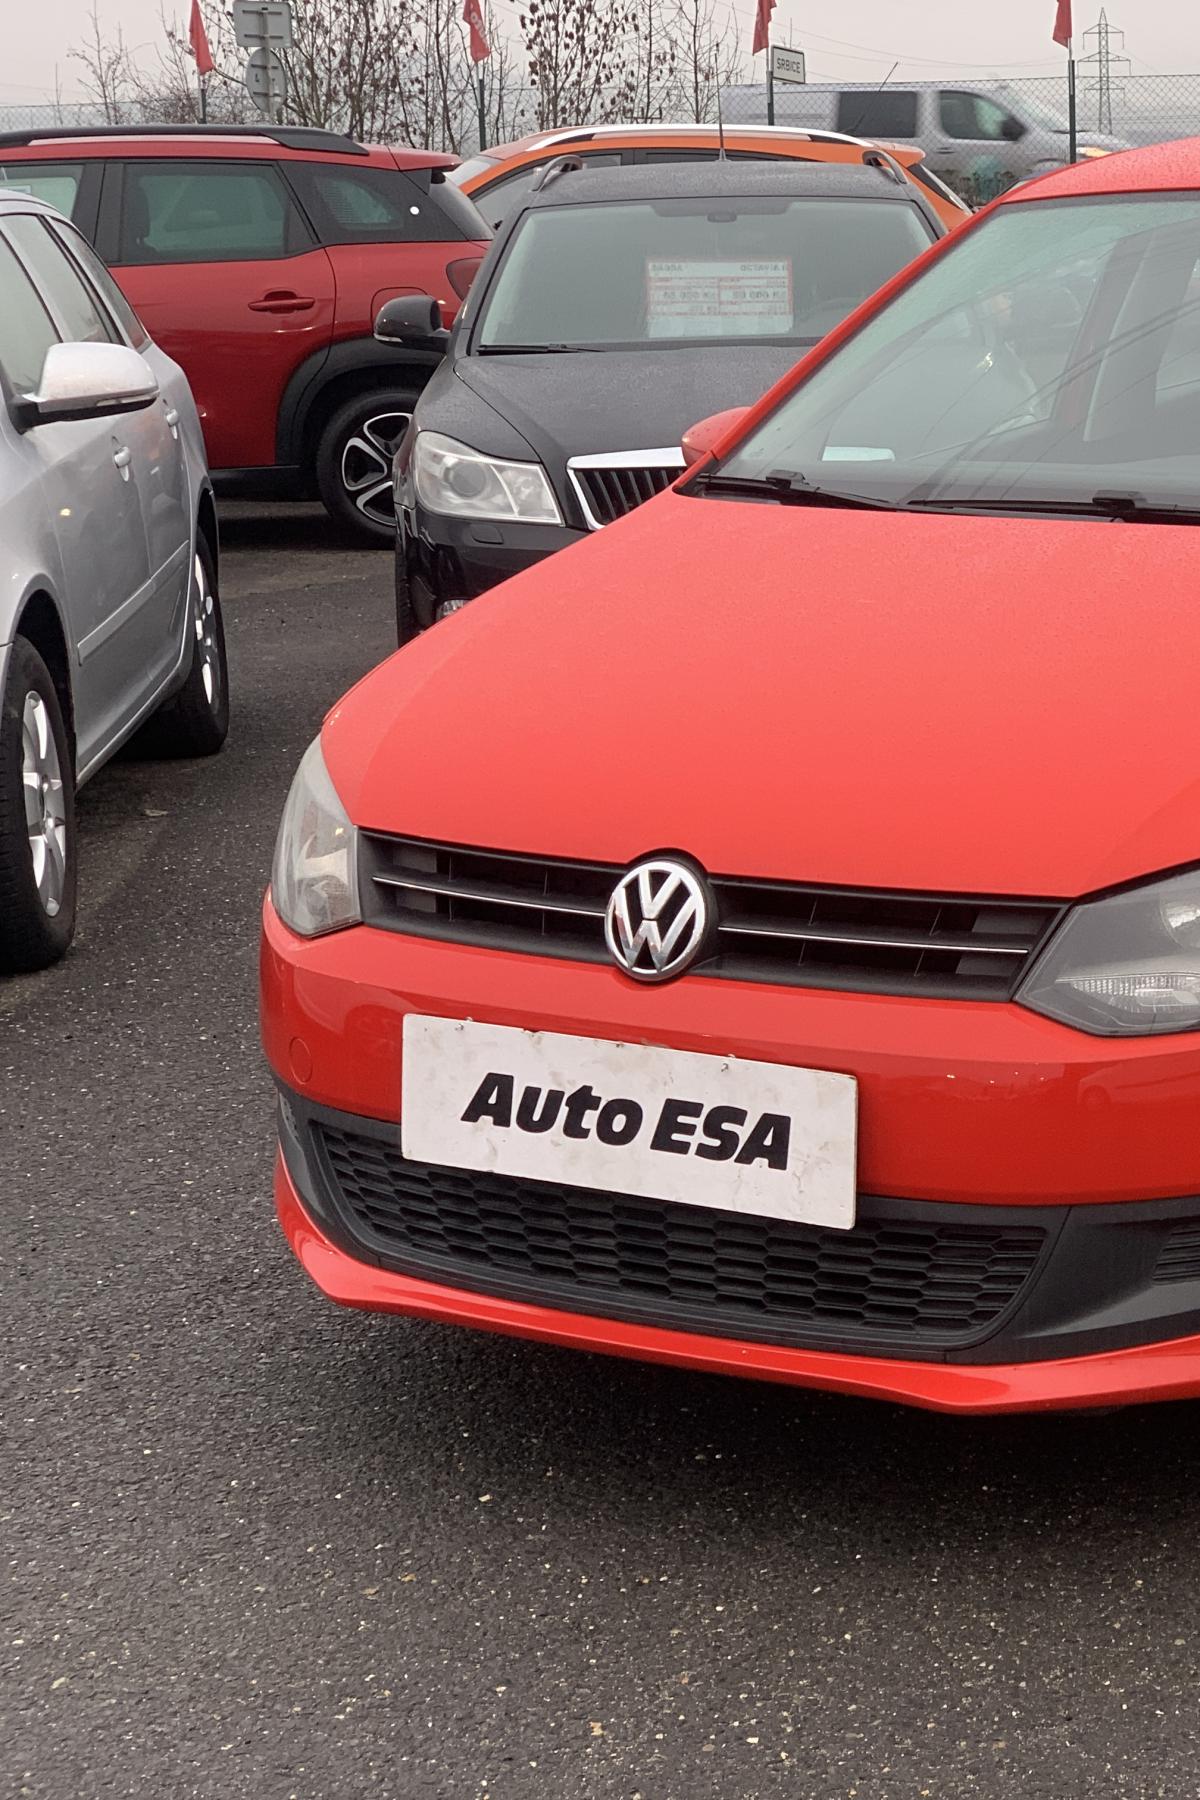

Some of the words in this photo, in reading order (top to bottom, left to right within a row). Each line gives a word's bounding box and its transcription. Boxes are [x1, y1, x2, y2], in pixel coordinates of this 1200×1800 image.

[776, 57, 801, 74] SRBICE
[605, 859, 707, 981] VW
[460, 1071, 643, 1147] Auto
[650, 1097, 792, 1171] ESA
